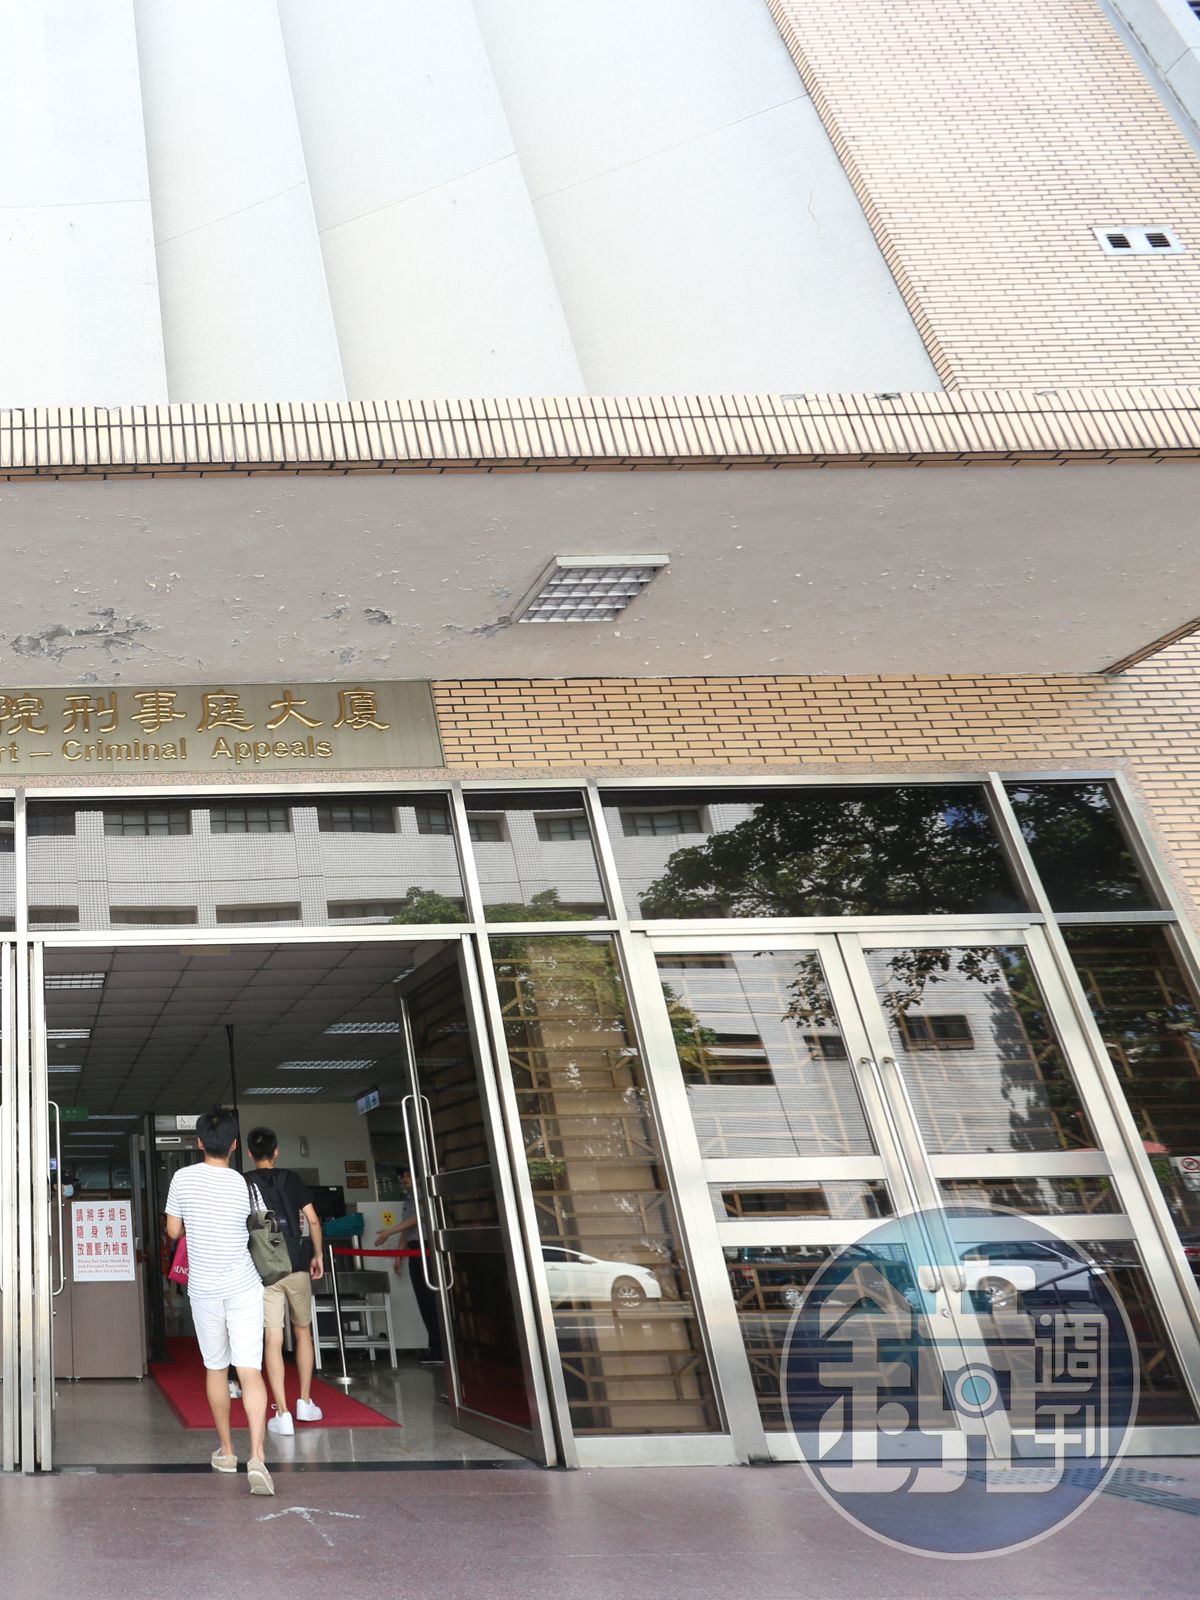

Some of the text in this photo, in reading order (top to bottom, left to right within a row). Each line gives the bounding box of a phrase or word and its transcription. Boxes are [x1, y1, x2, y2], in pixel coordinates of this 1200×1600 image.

[62, 737, 187, 762] Criminal
[211, 735, 333, 764] Appeals
[76, 1208, 127, 1222] 請將手提包
[76, 1225, 128, 1238] 隨身物品
